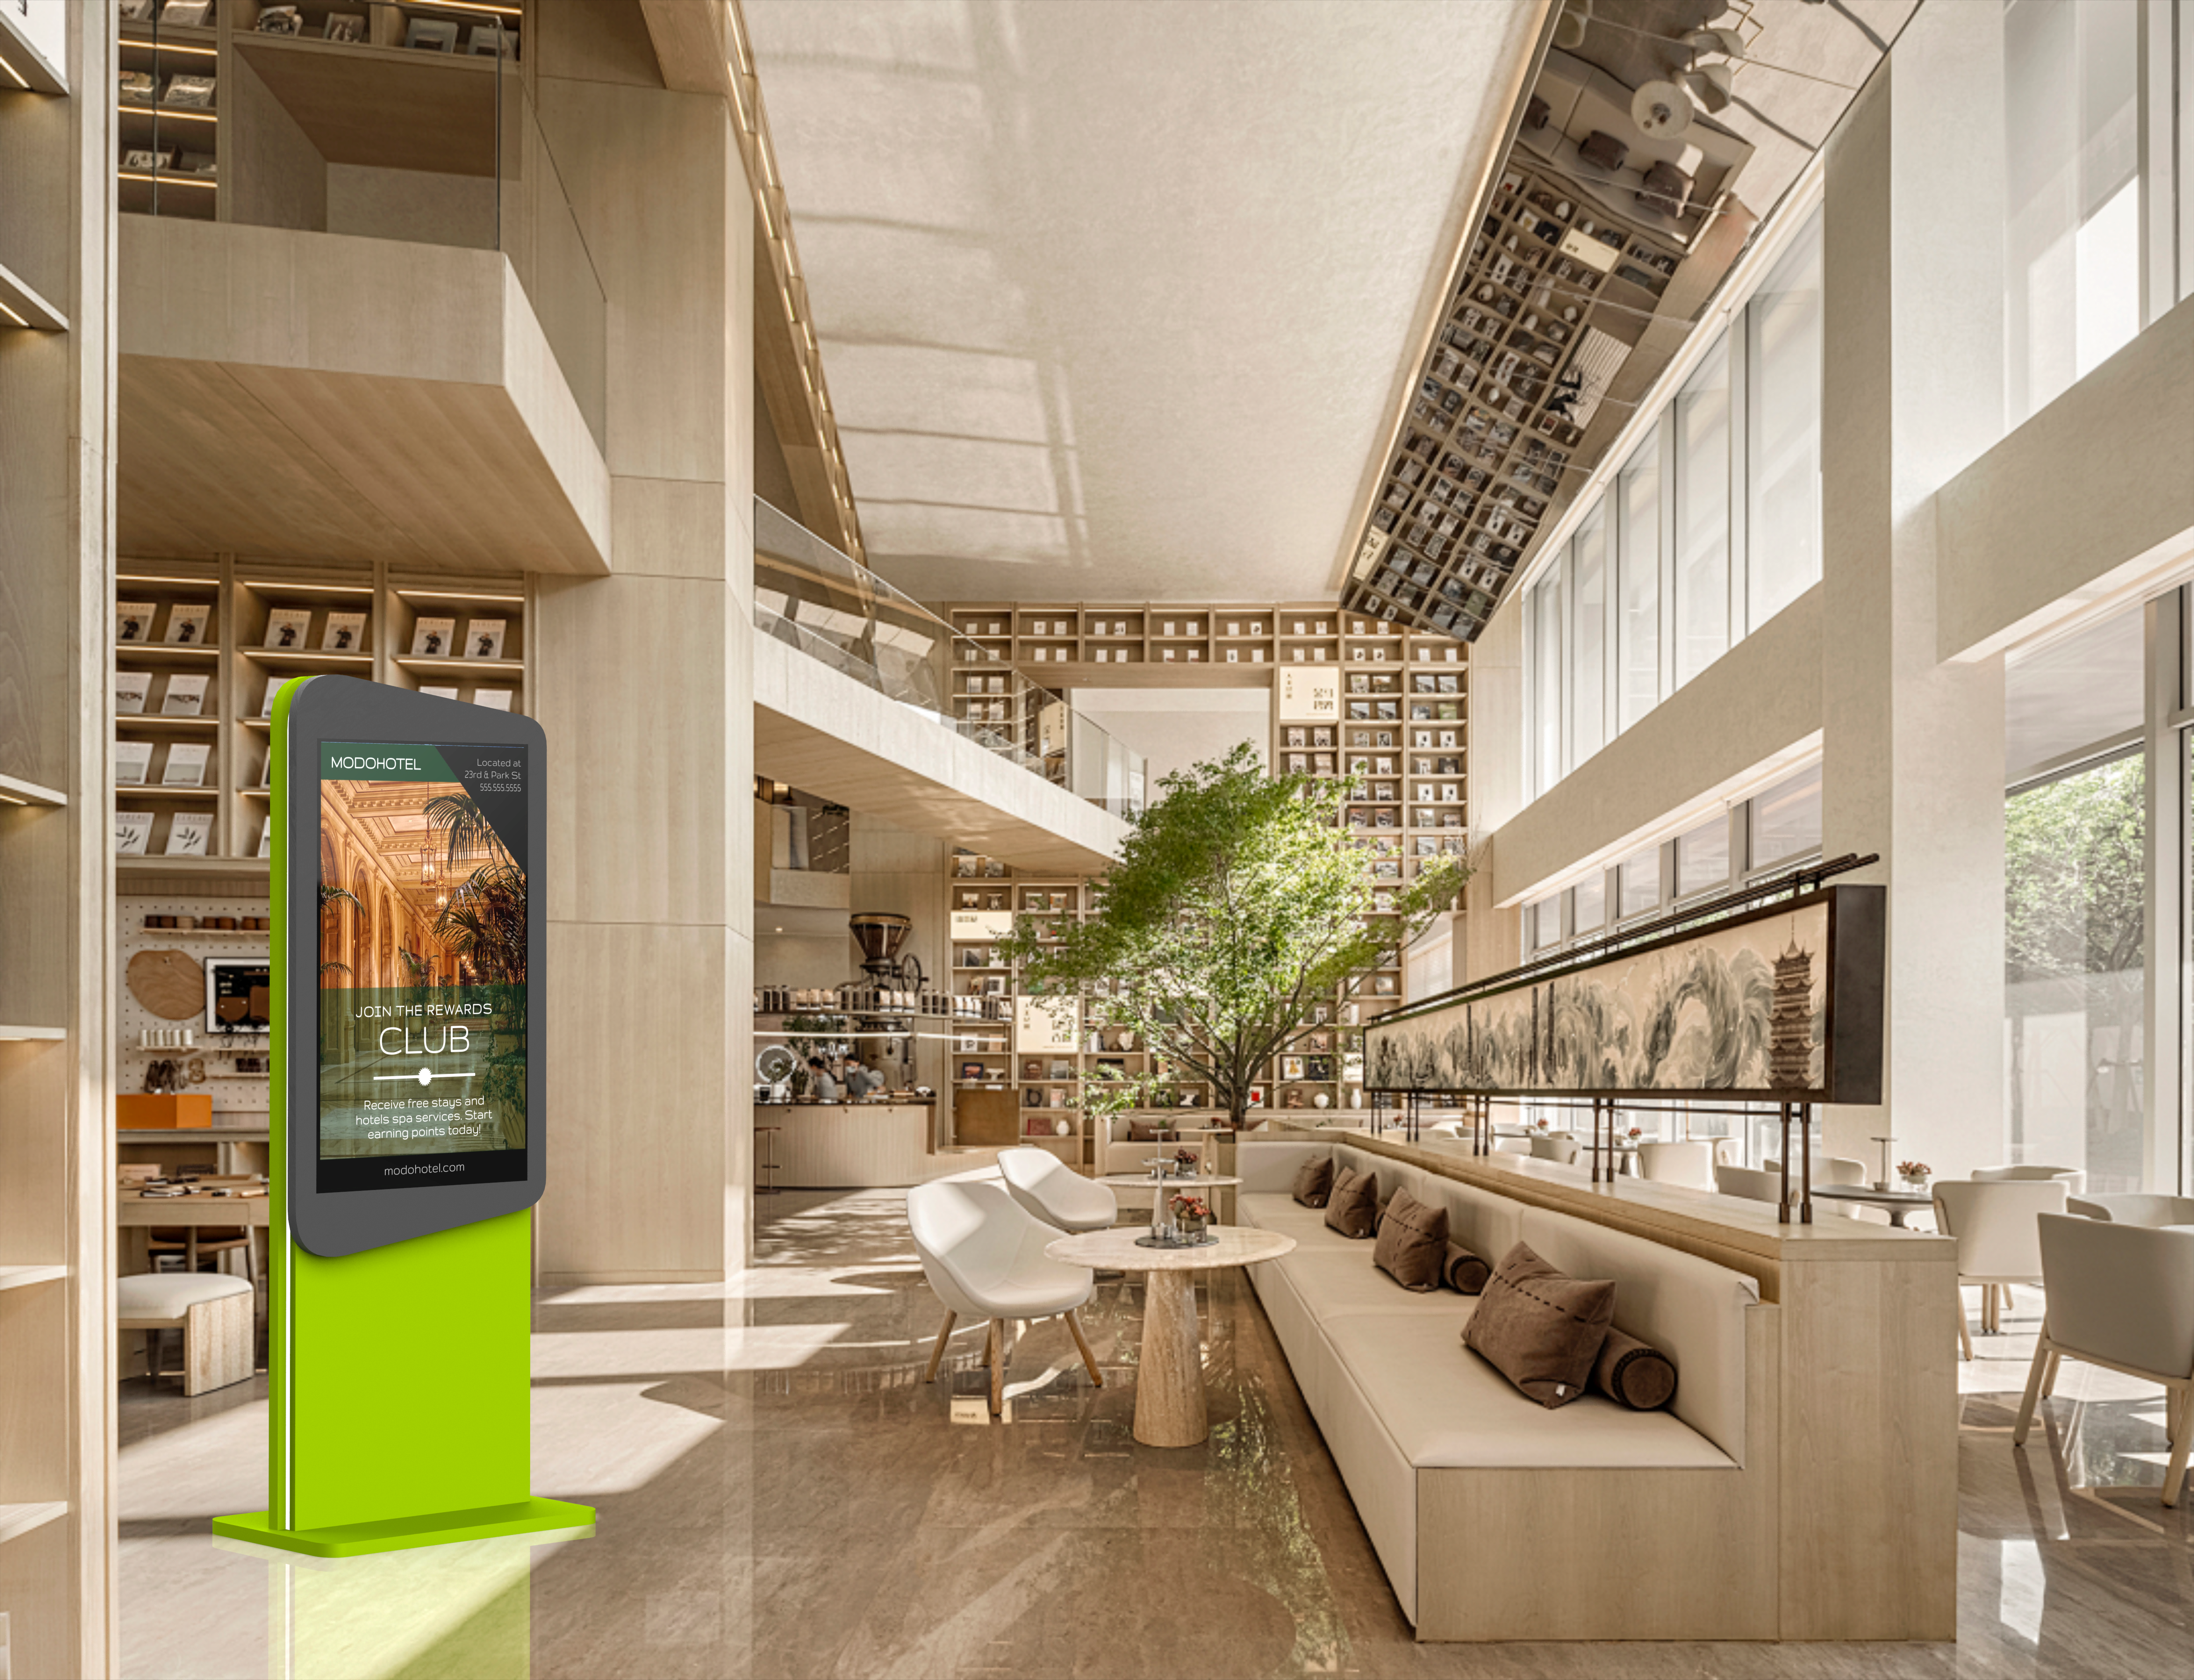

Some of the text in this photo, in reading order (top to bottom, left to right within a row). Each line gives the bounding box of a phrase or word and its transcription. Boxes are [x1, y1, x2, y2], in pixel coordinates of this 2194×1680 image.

[331, 756, 421, 770] MODOHOTEL
[477, 759, 511, 767] Located
[465, 770, 482, 778] 23rd
[484, 770, 489, 779] &
[480, 783, 521, 792] 555.555.5555
[355, 1003, 492, 1018] JOIN THE REWARDS
[380, 1025, 470, 1055] CLUB
[364, 1095, 484, 1110] Receive free stays and
[356, 1110, 492, 1126] hotels spa services. Start
[368, 1124, 480, 1140] earning points today!
[384, 1163, 464, 1175] modohotel.com
